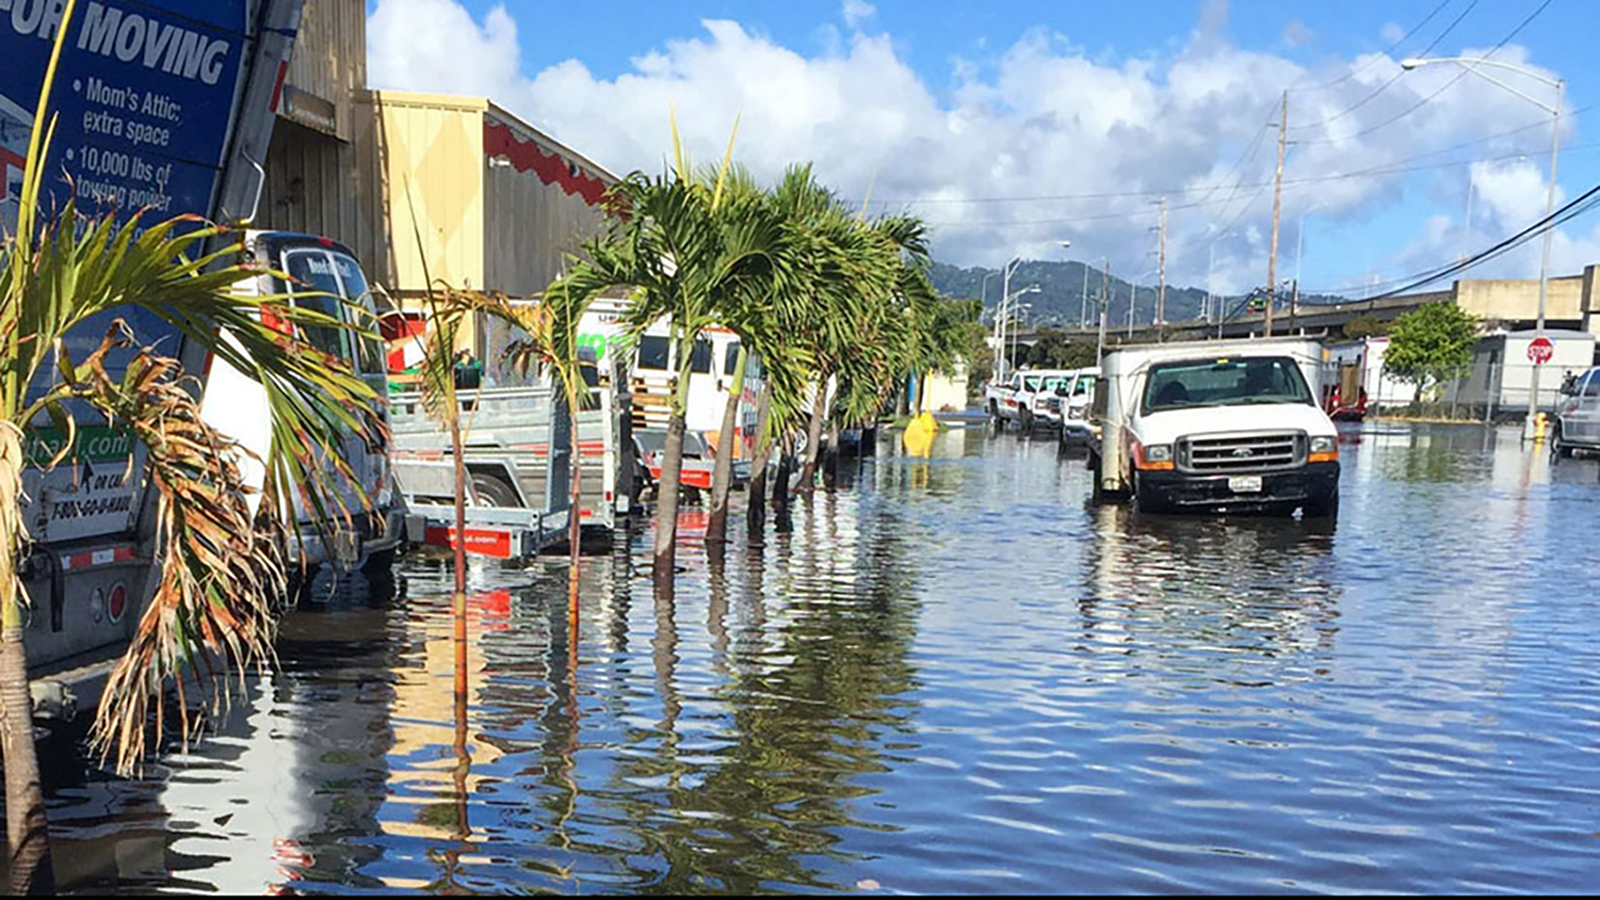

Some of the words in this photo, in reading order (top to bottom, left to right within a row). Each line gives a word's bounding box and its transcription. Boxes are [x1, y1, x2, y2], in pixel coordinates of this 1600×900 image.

[0, 0, 66, 41] OR
[77, 2, 230, 85] MOVING
[86, 77, 138, 112] Mom's
[83, 111, 122, 136] extra
[126, 121, 169, 146] space
[80, 145, 129, 176] 10,000
[131, 157, 154, 182] lbs
[156, 163, 172, 185] of
[76, 174, 127, 210] towing
[1528, 345, 1552, 357] STOP
